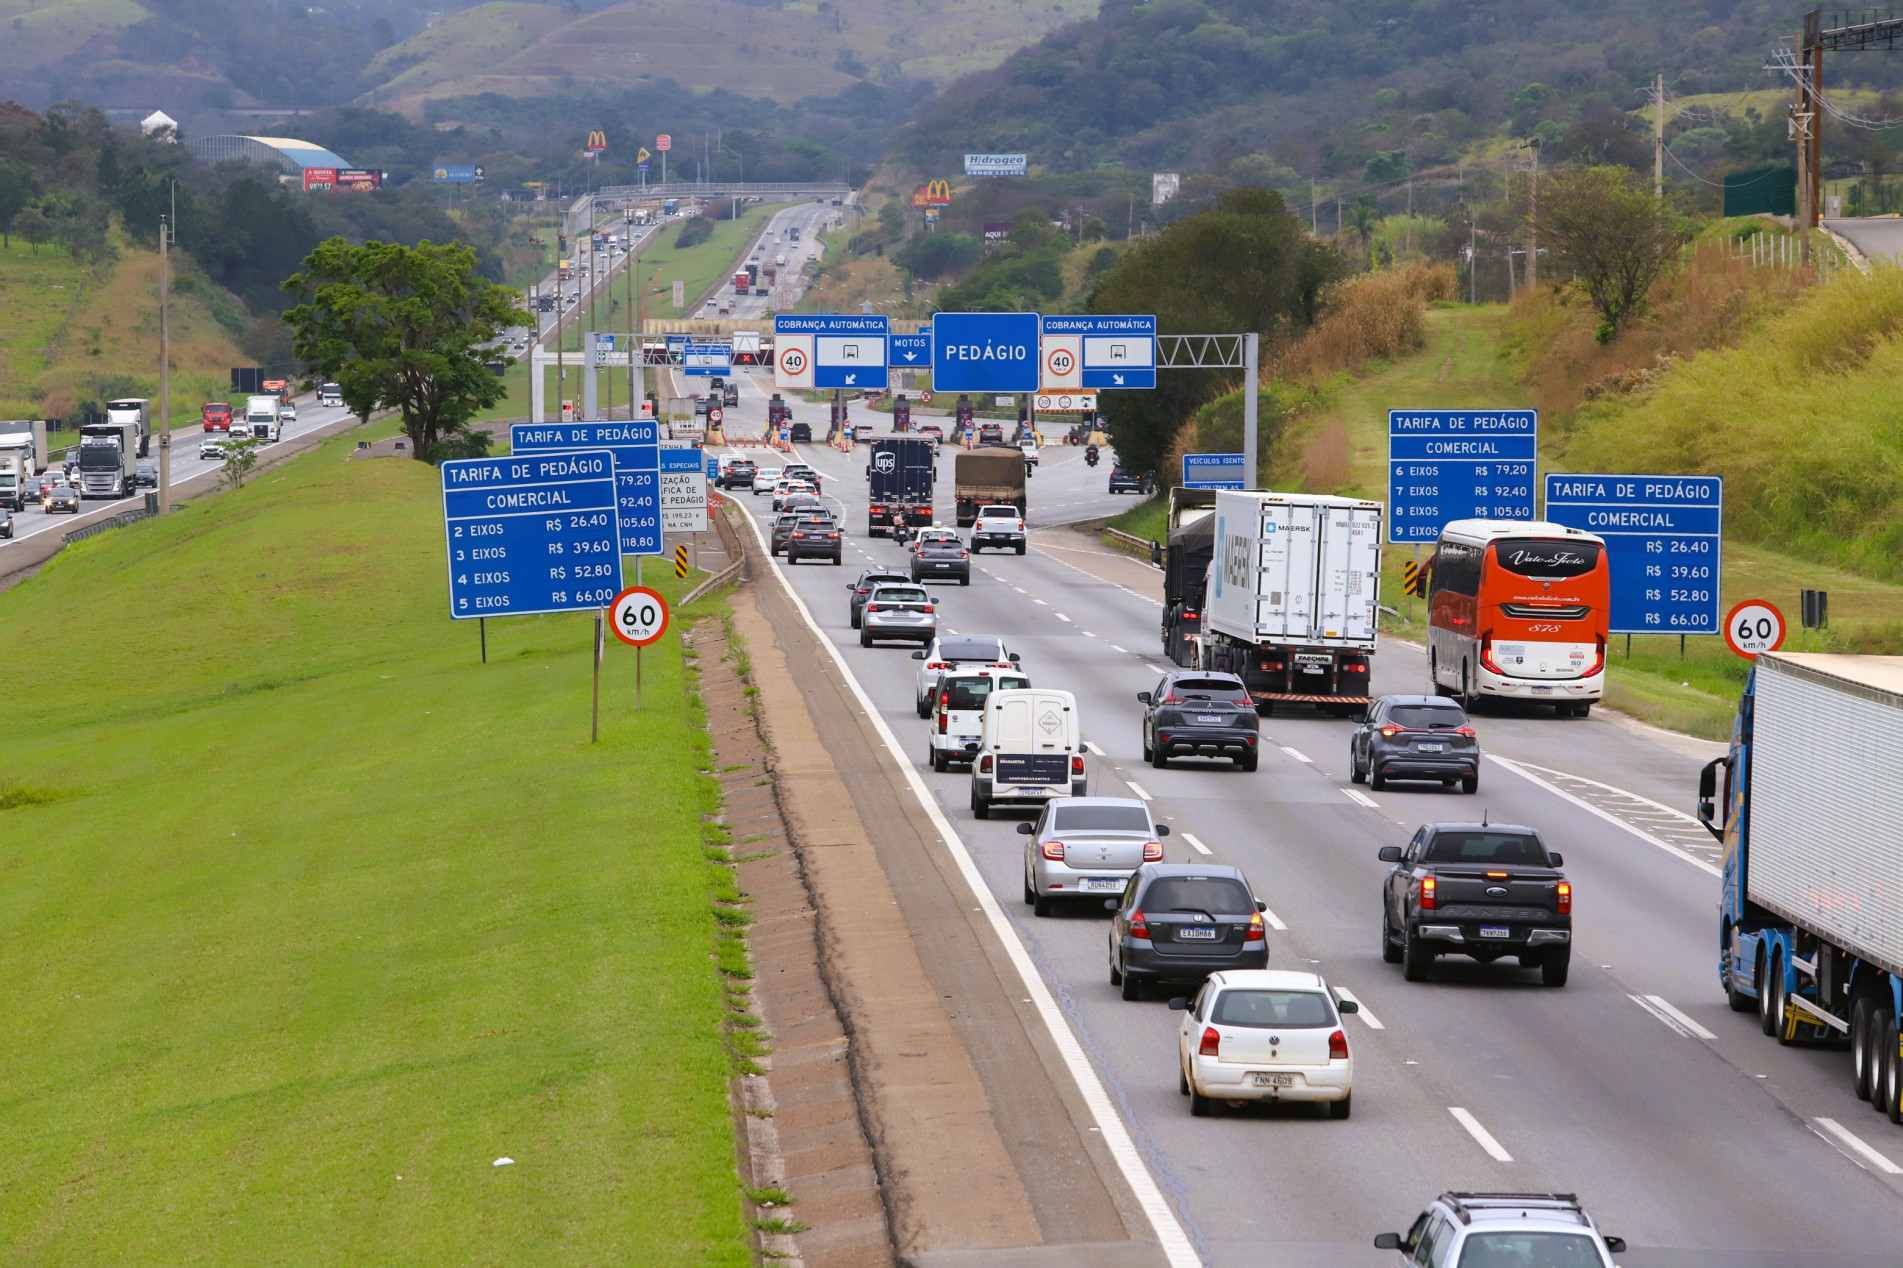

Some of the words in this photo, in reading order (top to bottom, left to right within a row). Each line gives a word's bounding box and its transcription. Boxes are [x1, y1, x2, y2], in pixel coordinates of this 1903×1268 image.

[778, 320, 826, 331] COBRANÇA
[829, 318, 884, 329] AUTOMÁTICA
[1046, 321, 1093, 331] COBRANÇA
[1097, 318, 1151, 329] AUTOMÁTICA
[894, 338, 926, 347] MOTOS
[946, 339, 1026, 360] PEDÁGIO
[785, 355, 802, 367] 40
[1053, 356, 1069, 367] 40
[1396, 417, 1441, 429] TARIFA
[1449, 417, 1466, 429] DE
[1474, 413, 1529, 429] PEDÁGIO
[518, 431, 563, 443] TARIFA
[572, 429, 589, 441] DE
[597, 425, 652, 440] PEDÁGIO
[1426, 442, 1499, 454] COMERCIAL
[450, 466, 502, 483] TARIFA
[511, 464, 531, 479] DE
[540, 456, 603, 477] PEDÁGIO
[877, 458, 893, 471] ups
[1395, 466, 1404, 476] 6
[1409, 466, 1439, 476] EIXOS
[1475, 466, 1488, 477] R$
[1495, 464, 1527, 475] 79.20
[620, 475, 652, 485] 79.20
[1395, 486, 1404, 496] 7
[1409, 486, 1439, 496] EIXOS
[1475, 486, 1488, 497] R$
[1495, 486, 1527, 497] 92.40
[1553, 482, 1606, 497] TARIFA
[1616, 484, 1635, 498] DE
[1645, 480, 1710, 499] PEDÁGIO
[487, 490, 571, 509] COMERCIAL
[620, 496, 652, 507] 92.40
[670, 494, 704, 504] PEDÁGIO
[1395, 506, 1403, 516] 8
[1409, 506, 1439, 516] EIXOS
[1475, 506, 1488, 517] R$
[1494, 506, 1529, 517] 105.60
[454, 527, 463, 537] 2
[470, 523, 504, 537] EIXOS
[546, 518, 562, 532] R$
[570, 514, 608, 528] 26.40
[620, 517, 655, 528] 105.60
[1588, 512, 1674, 527] COMERCIAL
[1395, 526, 1403, 536] 9
[1409, 526, 1439, 536] EIXOS
[622, 536, 654, 547] 118.80
[1646, 540, 1663, 554] R$
[1670, 541, 1709, 553] 26.40
[456, 550, 465, 560] 3
[472, 547, 506, 560] EIXOS
[548, 542, 564, 554] R$
[573, 540, 610, 554] 39.60
[457, 574, 467, 584] 4
[474, 571, 510, 584] EIXOS
[550, 566, 566, 580] R$
[574, 564, 612, 578] 52.80
[1646, 565, 1661, 577] R$
[459, 598, 468, 609] 5
[475, 595, 510, 608] EIXOS
[552, 590, 567, 603] R$
[575, 588, 613, 602] 66.00
[1645, 589, 1661, 601] R$
[1670, 589, 1709, 602] 52.80
[622, 605, 655, 626] 60
[1645, 612, 1660, 625] R$
[1670, 613, 1709, 626] 66.00
[627, 628, 650, 636] km/h
[1738, 618, 1771, 639] 60
